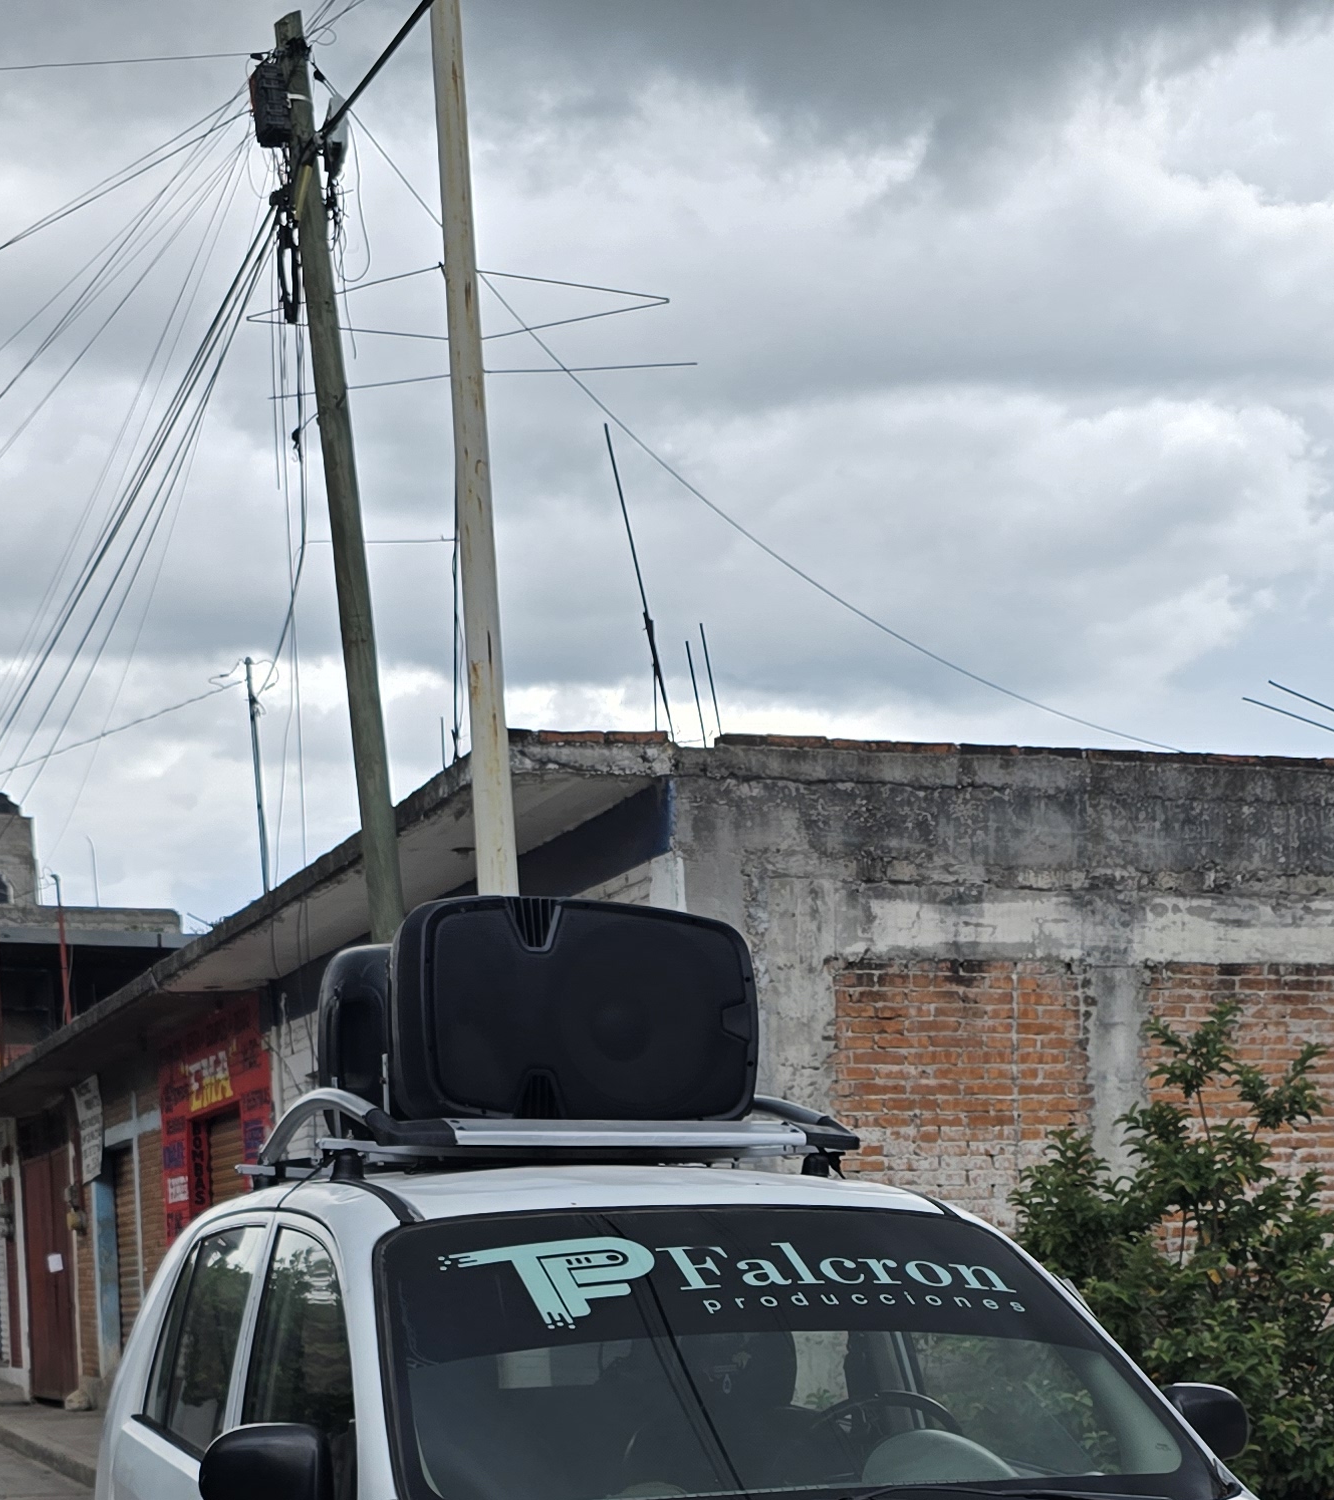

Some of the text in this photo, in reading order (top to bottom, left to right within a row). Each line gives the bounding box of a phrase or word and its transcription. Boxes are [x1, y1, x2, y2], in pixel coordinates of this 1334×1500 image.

[191, 1121, 206, 1205] BOMBAS
[655, 1242, 1017, 1294] Falcron
[702, 1290, 1026, 1315] producciones
